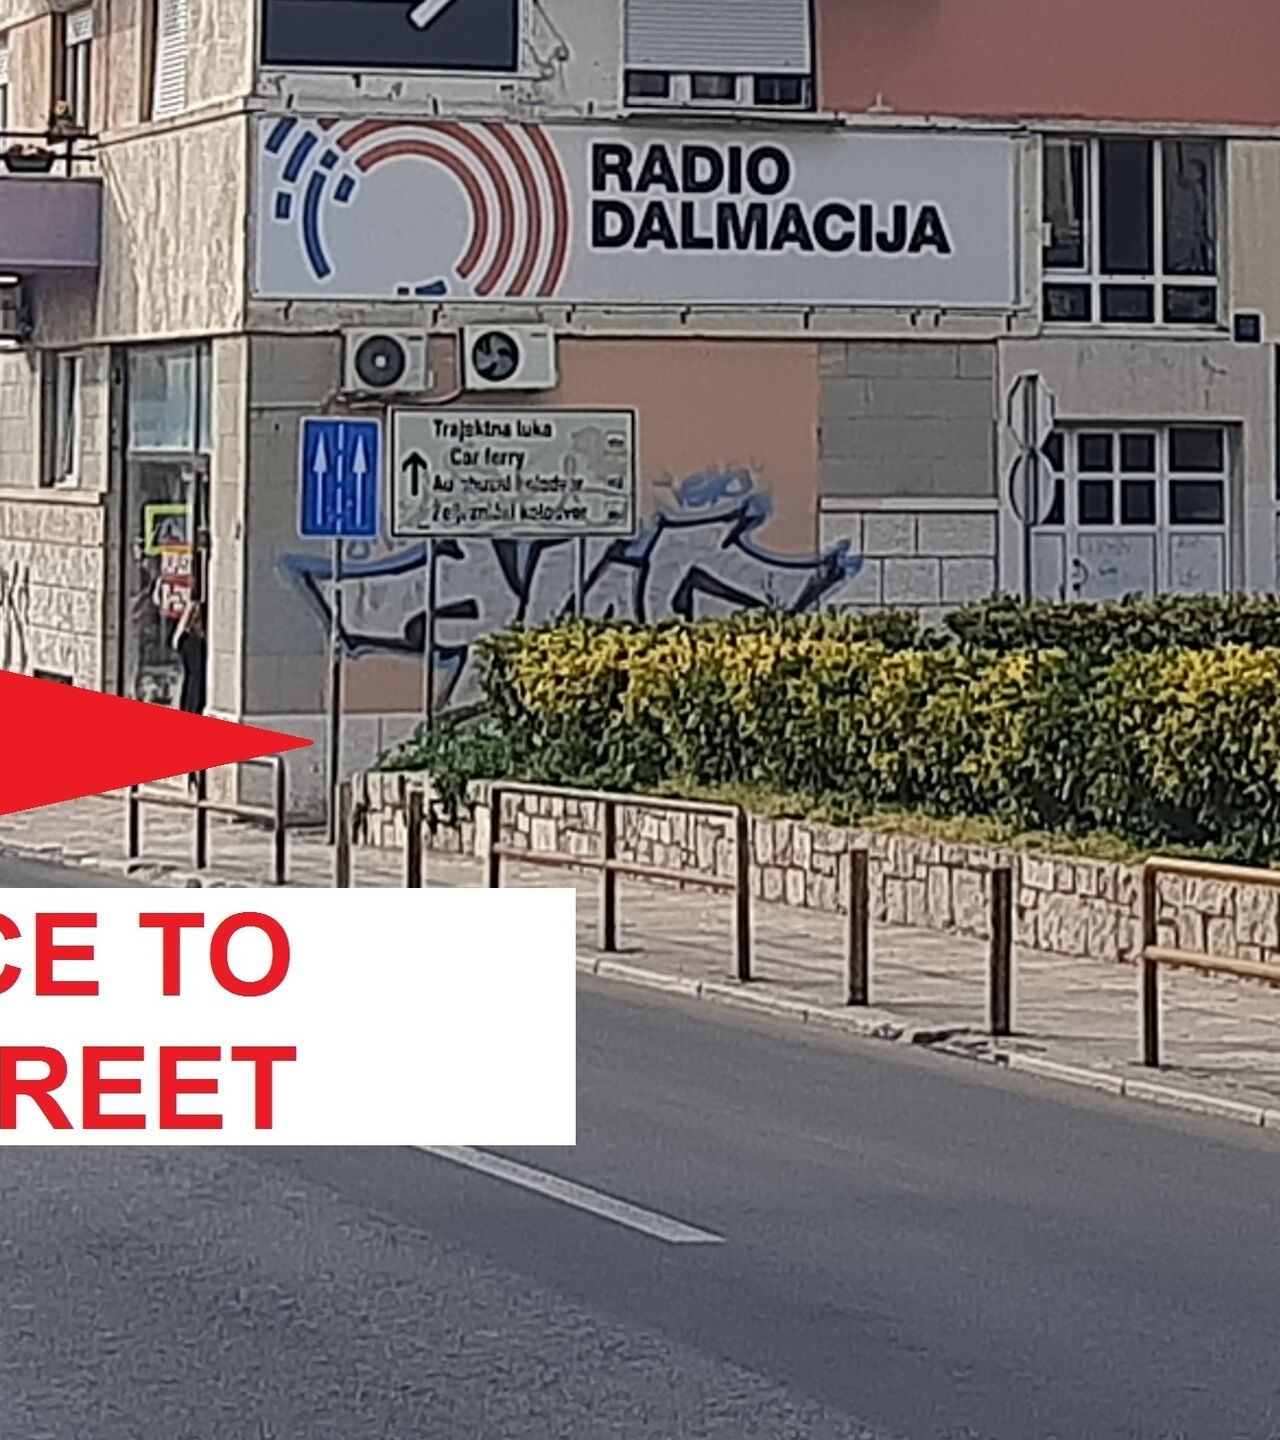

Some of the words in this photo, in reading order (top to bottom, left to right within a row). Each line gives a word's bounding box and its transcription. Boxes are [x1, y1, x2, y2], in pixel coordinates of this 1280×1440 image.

[592, 143, 790, 195] RADIO
[592, 200, 951, 254] DALMACIJA
[432, 419, 512, 441] Trajektna
[516, 419, 553, 437] luka
[450, 447, 480, 466] Car
[484, 447, 526, 470] ferry
